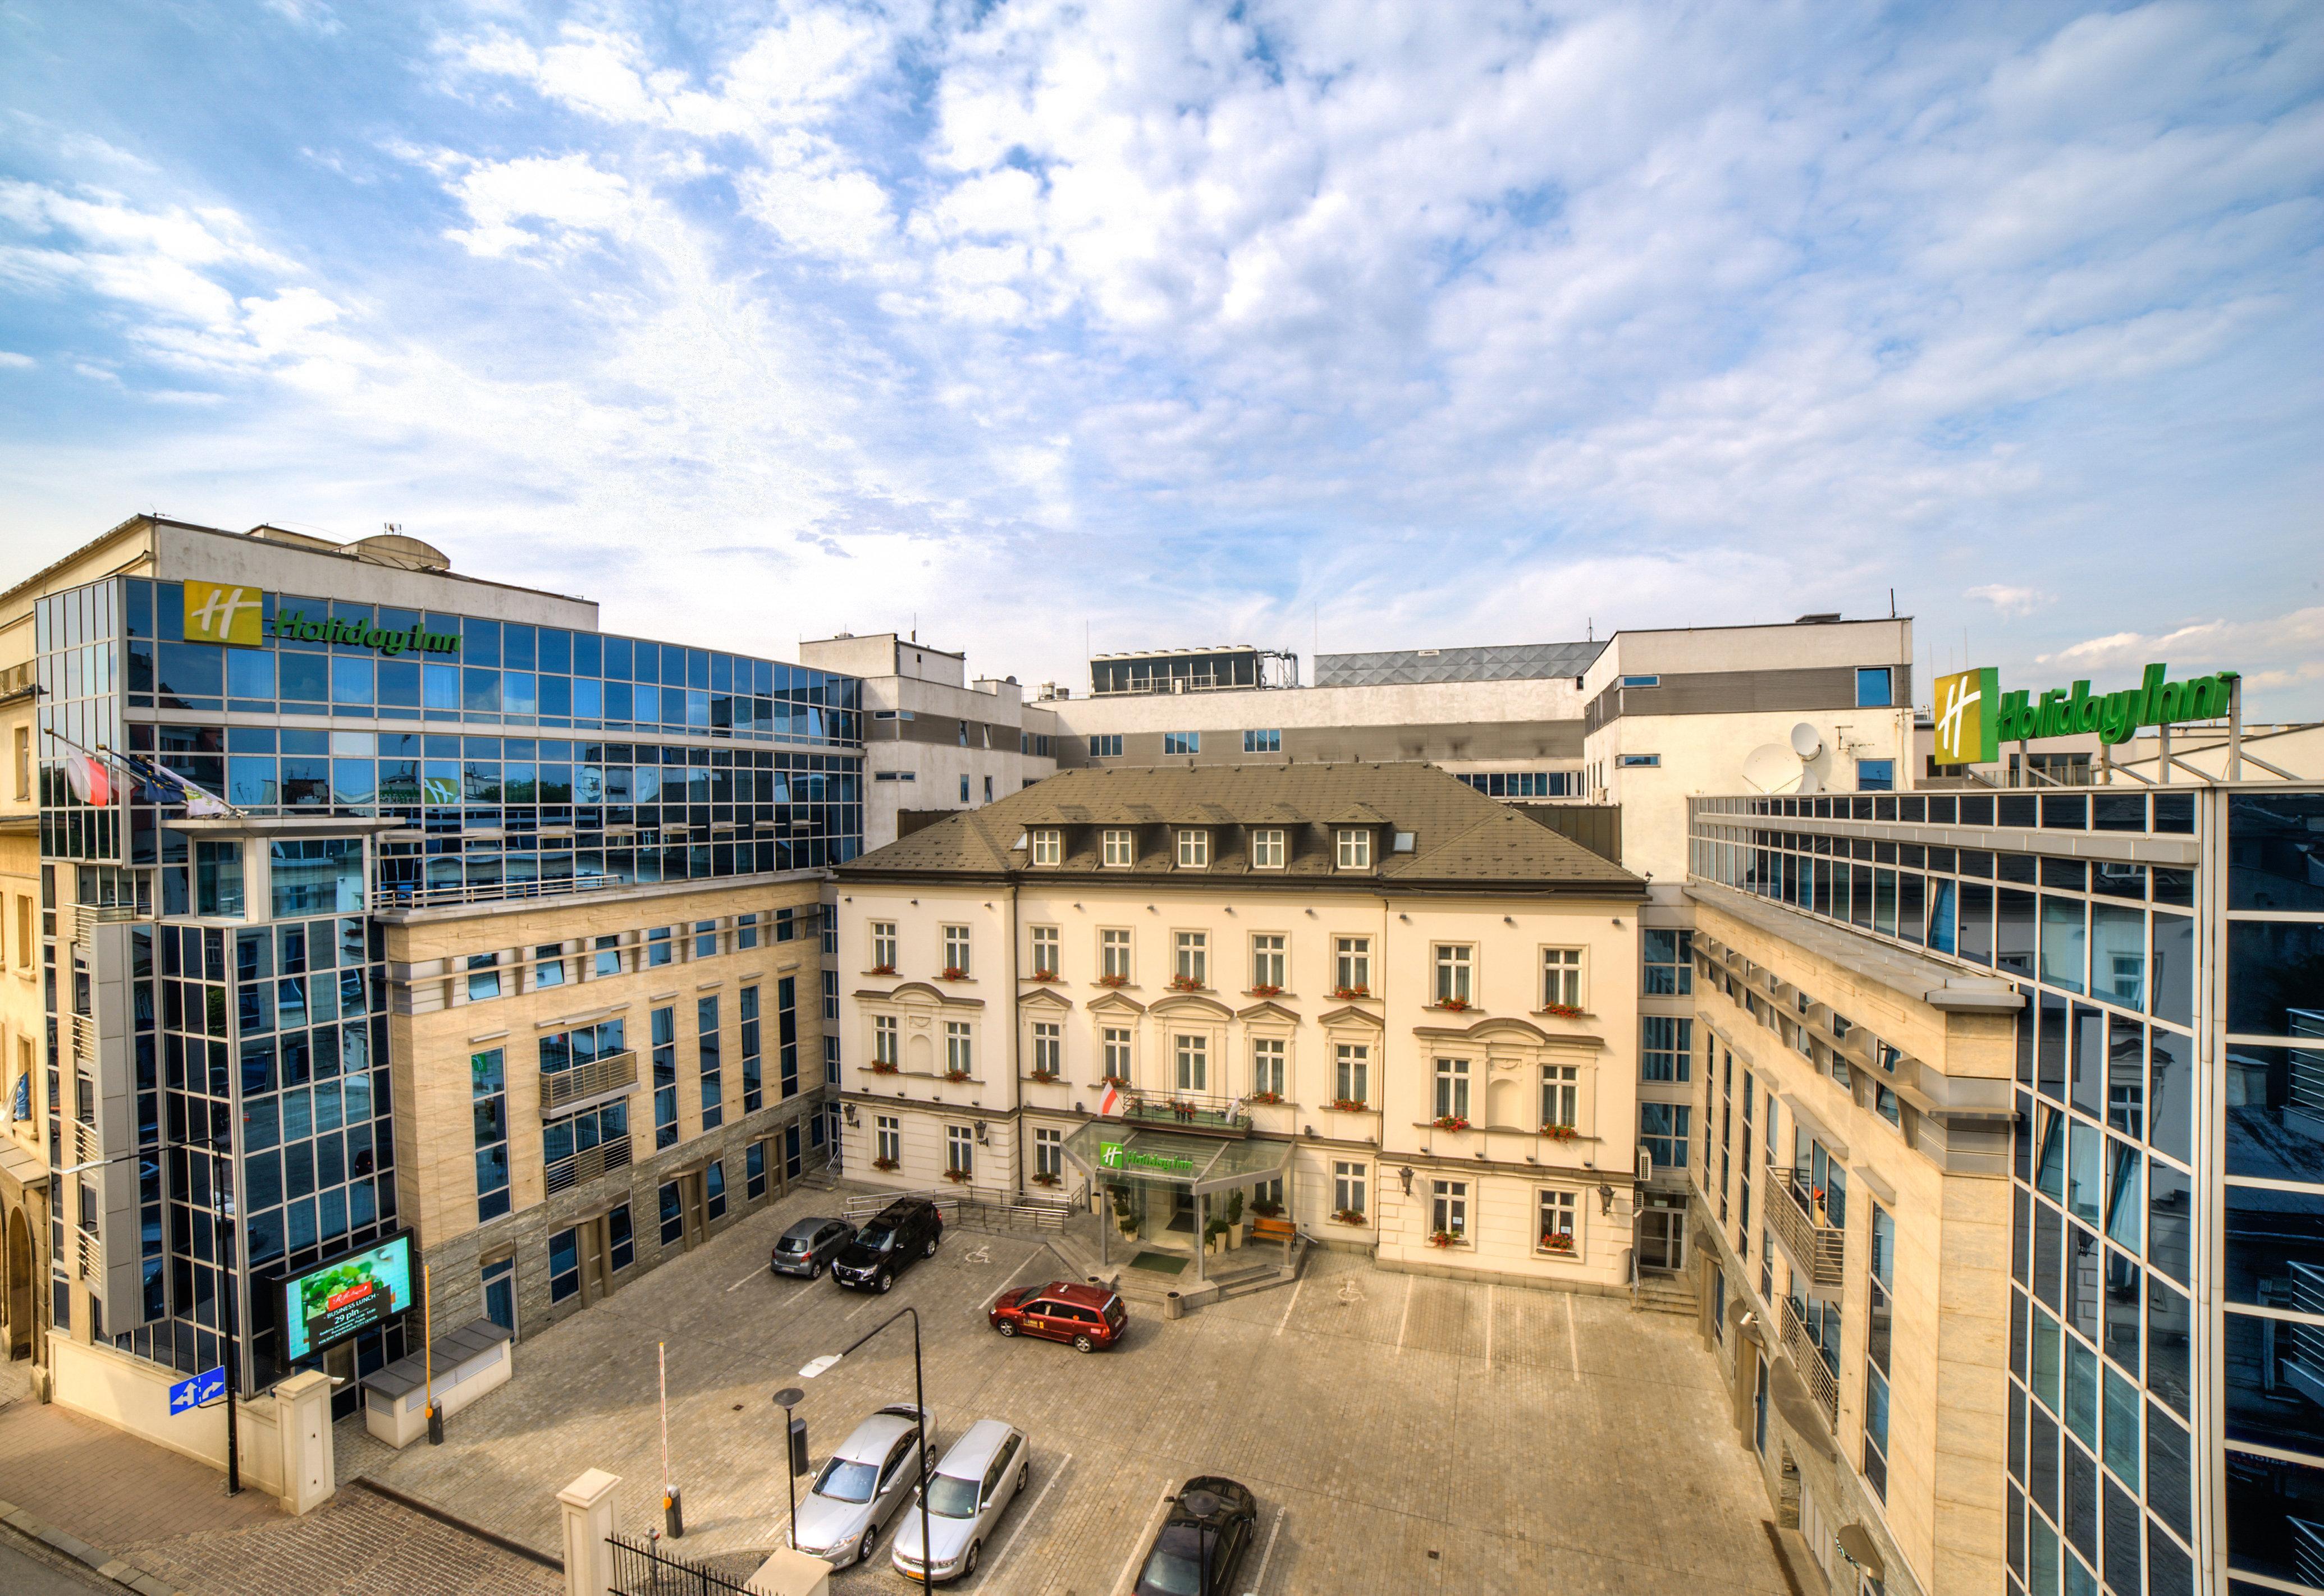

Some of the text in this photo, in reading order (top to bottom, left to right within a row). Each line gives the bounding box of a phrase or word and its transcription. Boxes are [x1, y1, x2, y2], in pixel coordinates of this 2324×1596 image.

[274, 609, 409, 654] Holiday
[413, 623, 463, 652] Inn
[1997, 680, 2142, 745] Holiday
[2137, 663, 2232, 726] Inn
[1126, 1151, 1172, 1170] Holiday
[1173, 1156, 1193, 1170] Inn
[327, 1303, 355, 1319] BUSINESS
[356, 1293, 376, 1306] LUNCH
[334, 1314, 345, 1324] 29
[346, 1309, 359, 1320] pln
